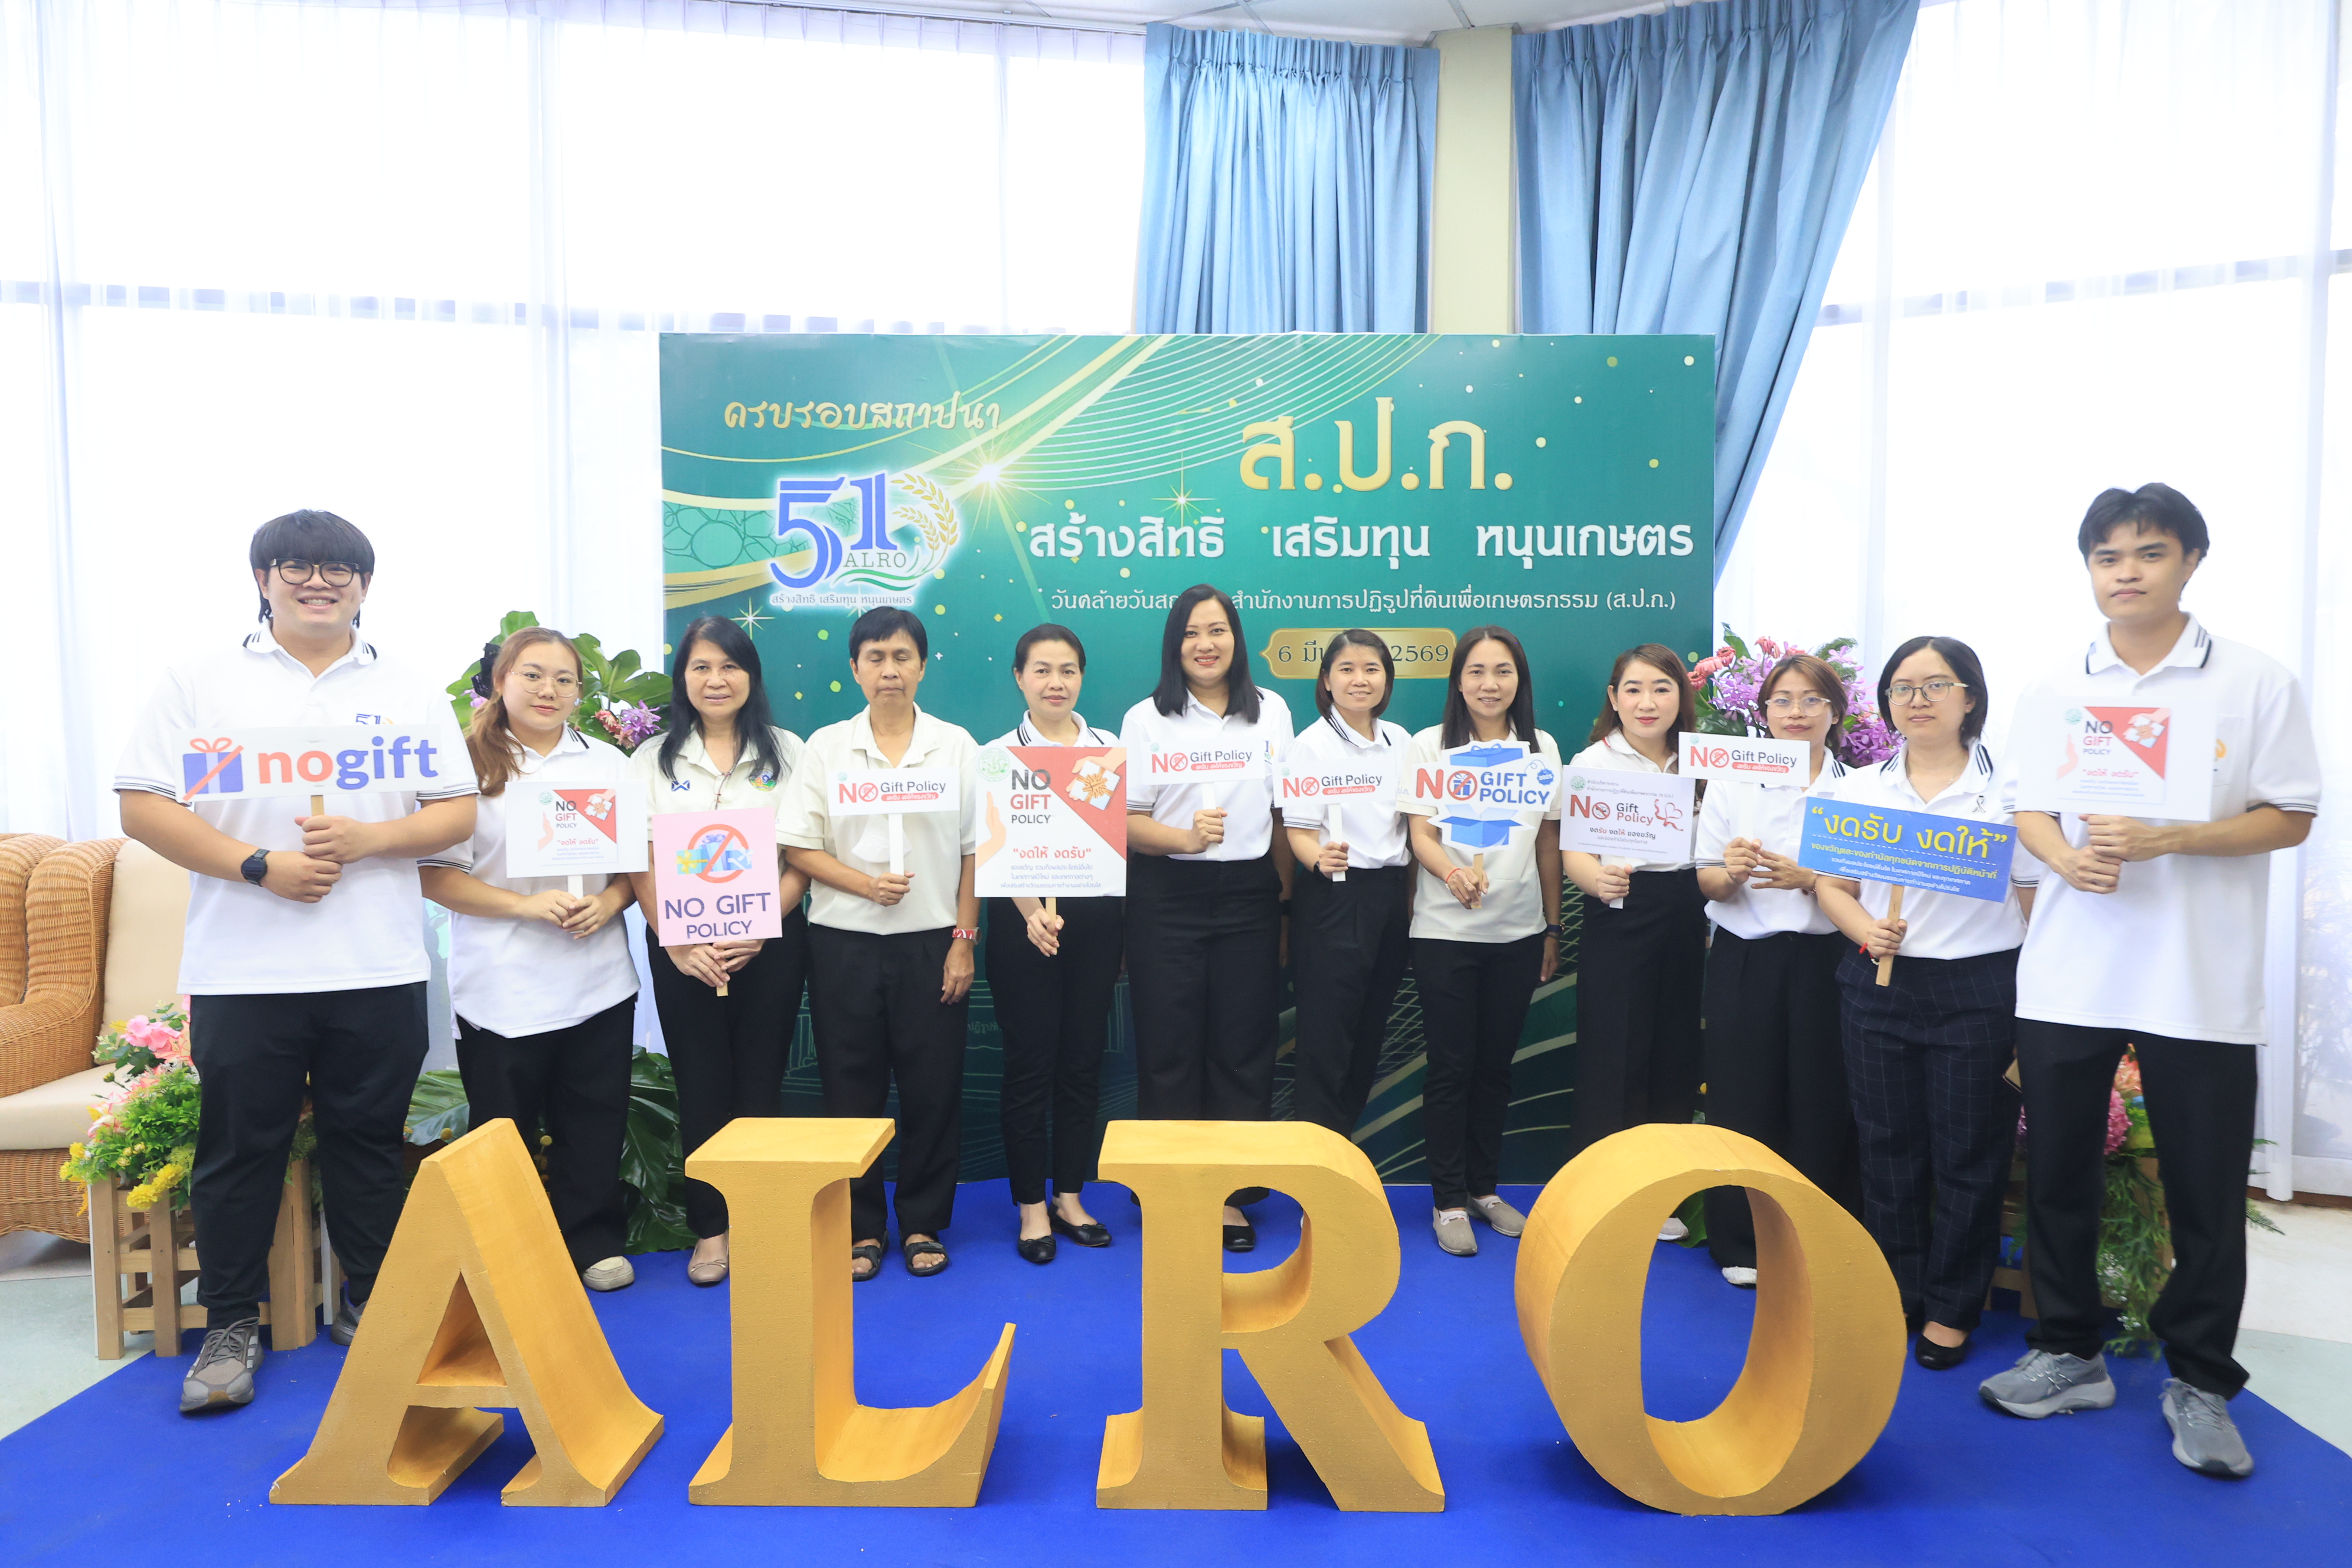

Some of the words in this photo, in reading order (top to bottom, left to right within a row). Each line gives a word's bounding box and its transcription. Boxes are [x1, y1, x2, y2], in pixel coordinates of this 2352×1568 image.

[724, 391, 1001, 430] ครบรอบสถาปนา
[1240, 396, 1514, 491] ส.ป.ก.
[770, 470, 897, 589] 51
[1030, 512, 1225, 558] สร้างสิทธิ
[1272, 515, 1430, 570] เสริมทุน
[1476, 520, 1694, 570] หนุนเกษตร
[844, 551, 907, 569] ALRO
[772, 593, 815, 604] สร้างสิทธิ
[819, 594, 857, 607] เสริมทุน
[861, 596, 912, 607] หนุนเกษตร
[1606, 589, 1676, 611] (ส.ป.ก.)
[1278, 645, 1292, 662] 6
[1391, 644, 1449, 662] 2569
[2085, 720, 2113, 734] NO
[2083, 736, 2112, 746] GIFT
[257, 736, 439, 790] nogift
[1190, 751, 1212, 762] Gift
[1215, 750, 1252, 762] Policy
[1732, 750, 1755, 761] Gift
[1758, 752, 1797, 767] Policy
[880, 782, 904, 793] Gift
[907, 780, 946, 793] Policy
[1011, 769, 1051, 790] NO
[1321, 776, 1343, 786] Gift
[1346, 774, 1382, 786] Policy
[1481, 771, 1527, 787] GIFT
[1010, 793, 1051, 810] GIFT
[1479, 788, 1550, 805] POLICY
[556, 800, 577, 811] NO
[1616, 802, 1639, 813] Gift
[555, 813, 577, 821] GIFT
[1011, 814, 1051, 824] POLICY
[1617, 813, 1654, 826] Policy
[665, 897, 705, 919] NO
[716, 892, 771, 915] GIFT
[687, 920, 753, 939] POLICY
[269, 1116, 1908, 1515] ALRO
